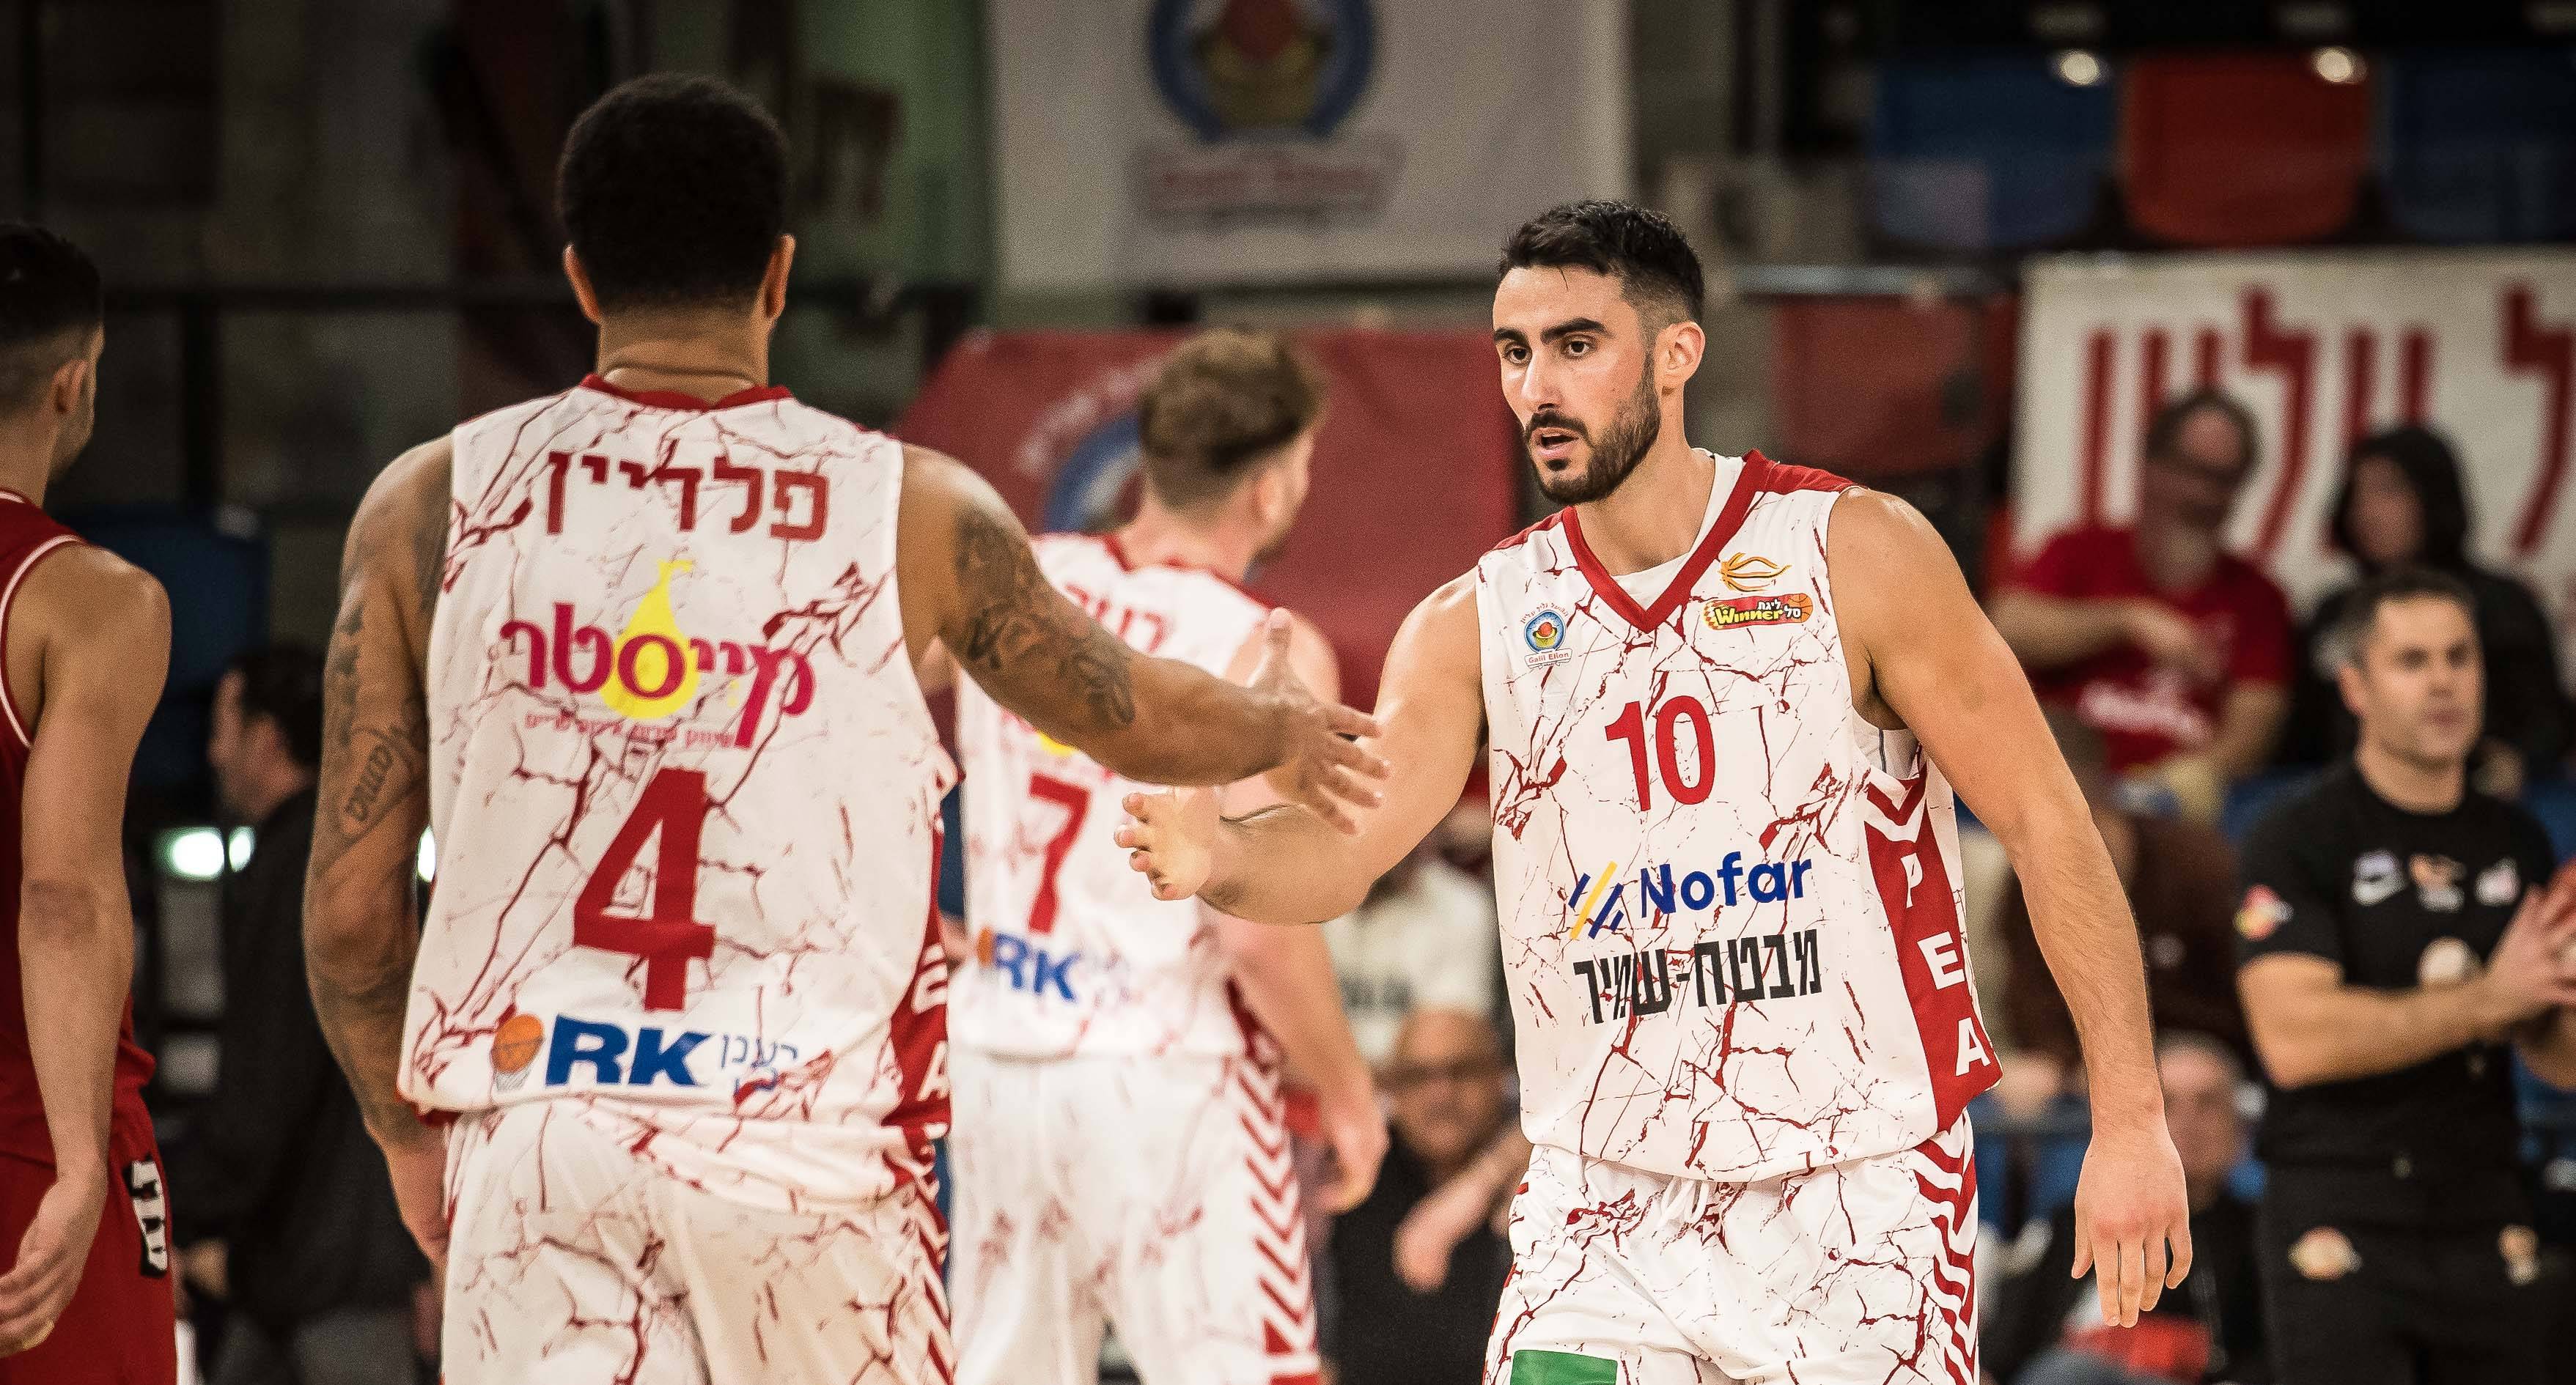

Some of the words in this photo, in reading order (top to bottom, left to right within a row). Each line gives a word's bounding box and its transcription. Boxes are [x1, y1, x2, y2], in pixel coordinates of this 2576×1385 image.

[547, 450, 830, 542] פלדיין
[1715, 605, 1784, 626] Winner
[1757, 598, 1781, 610] ליגת
[1784, 605, 1802, 619] סל
[500, 602, 815, 748] מייסטר
[1605, 695, 1716, 813] 10
[573, 766, 715, 1013] 4
[1027, 772, 1091, 936] 7
[1641, 851, 1812, 918] Nofar
[993, 931, 1082, 1002] RK
[1573, 928, 1822, 1024] מבטח-שמיר
[545, 1013, 715, 1087] RK
